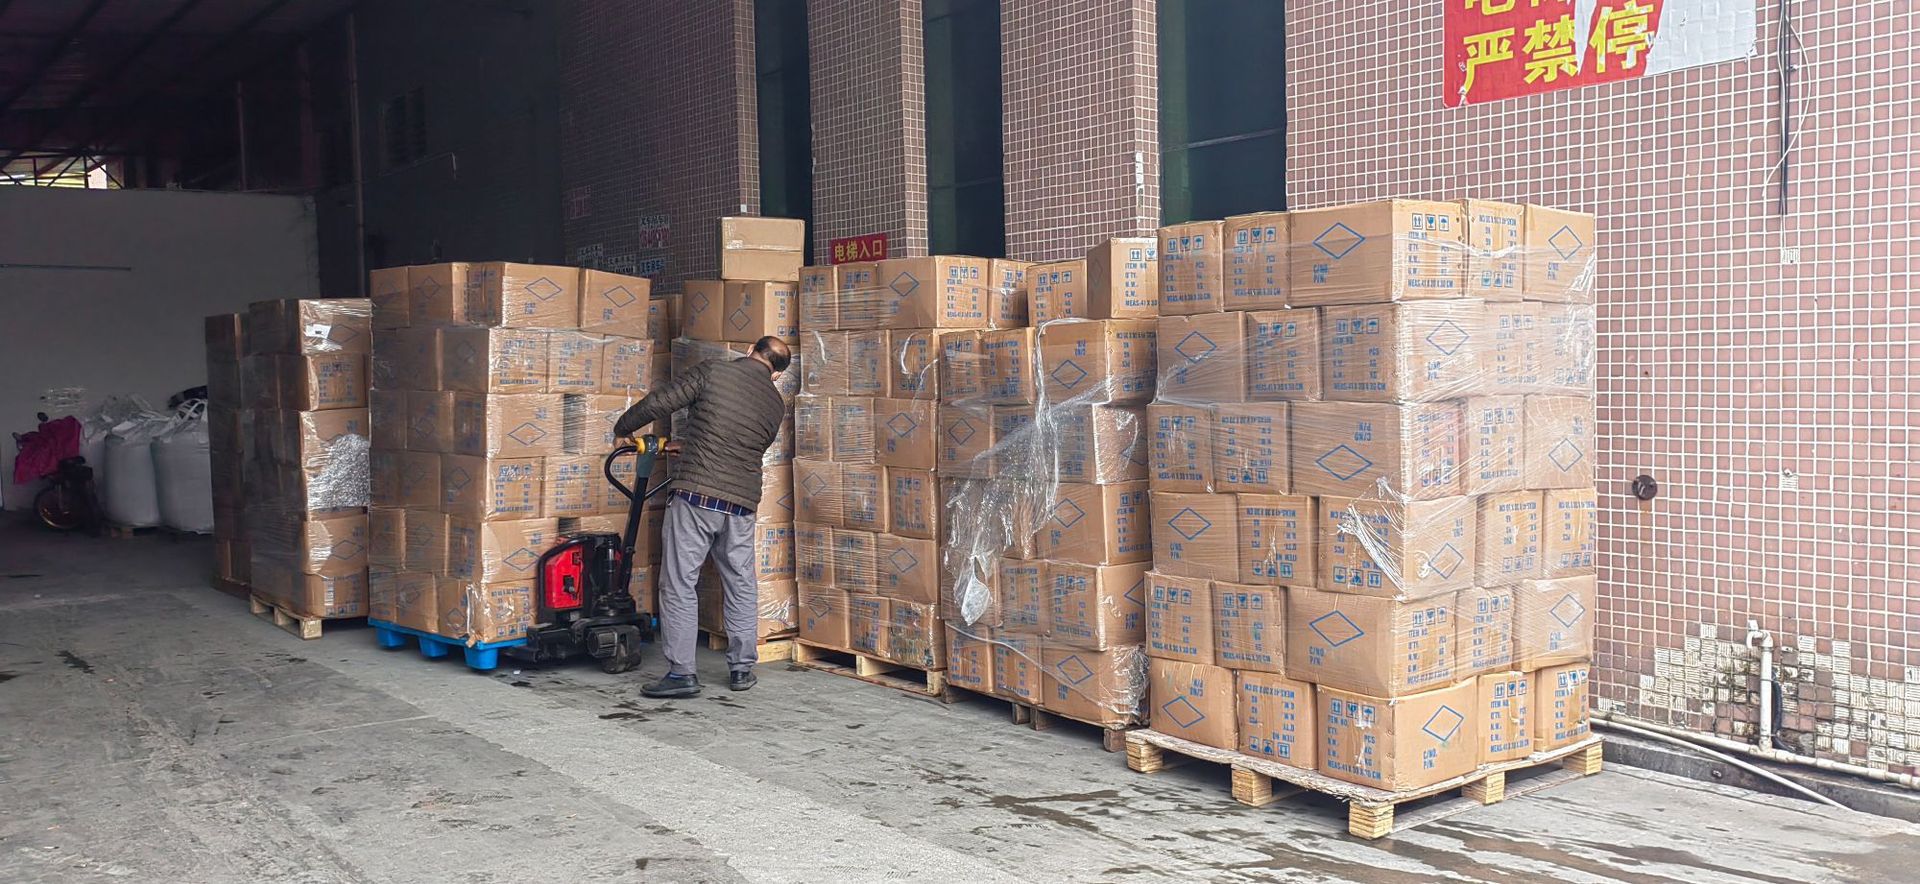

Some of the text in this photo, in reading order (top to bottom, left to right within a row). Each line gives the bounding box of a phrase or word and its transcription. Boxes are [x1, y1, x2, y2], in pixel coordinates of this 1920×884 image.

[1461, 2, 1654, 97] 严禁停
[834, 239, 883, 262] 电梯入口
